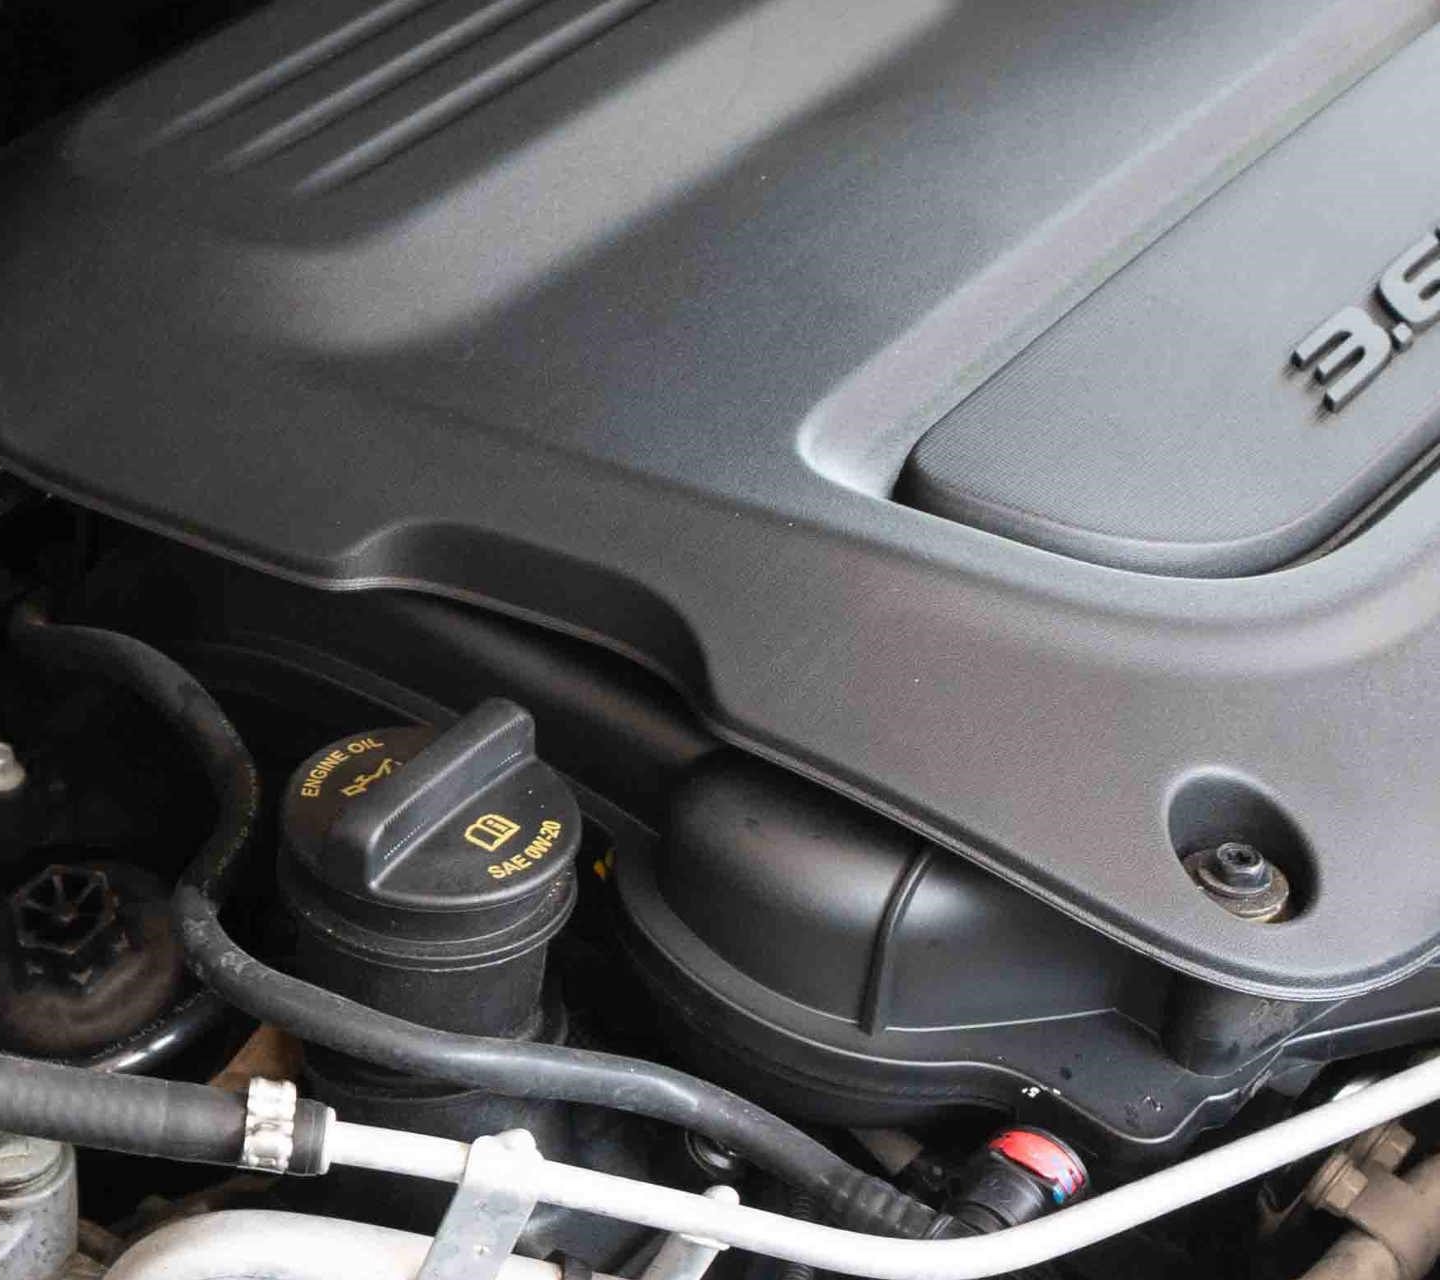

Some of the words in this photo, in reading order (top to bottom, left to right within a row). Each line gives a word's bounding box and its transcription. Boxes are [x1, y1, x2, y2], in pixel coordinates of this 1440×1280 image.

[301, 743, 347, 798] ENGINE
[347, 736, 385, 756] OIL
[486, 855, 533, 881] SAE
[523, 820, 563, 863] 0W-20
